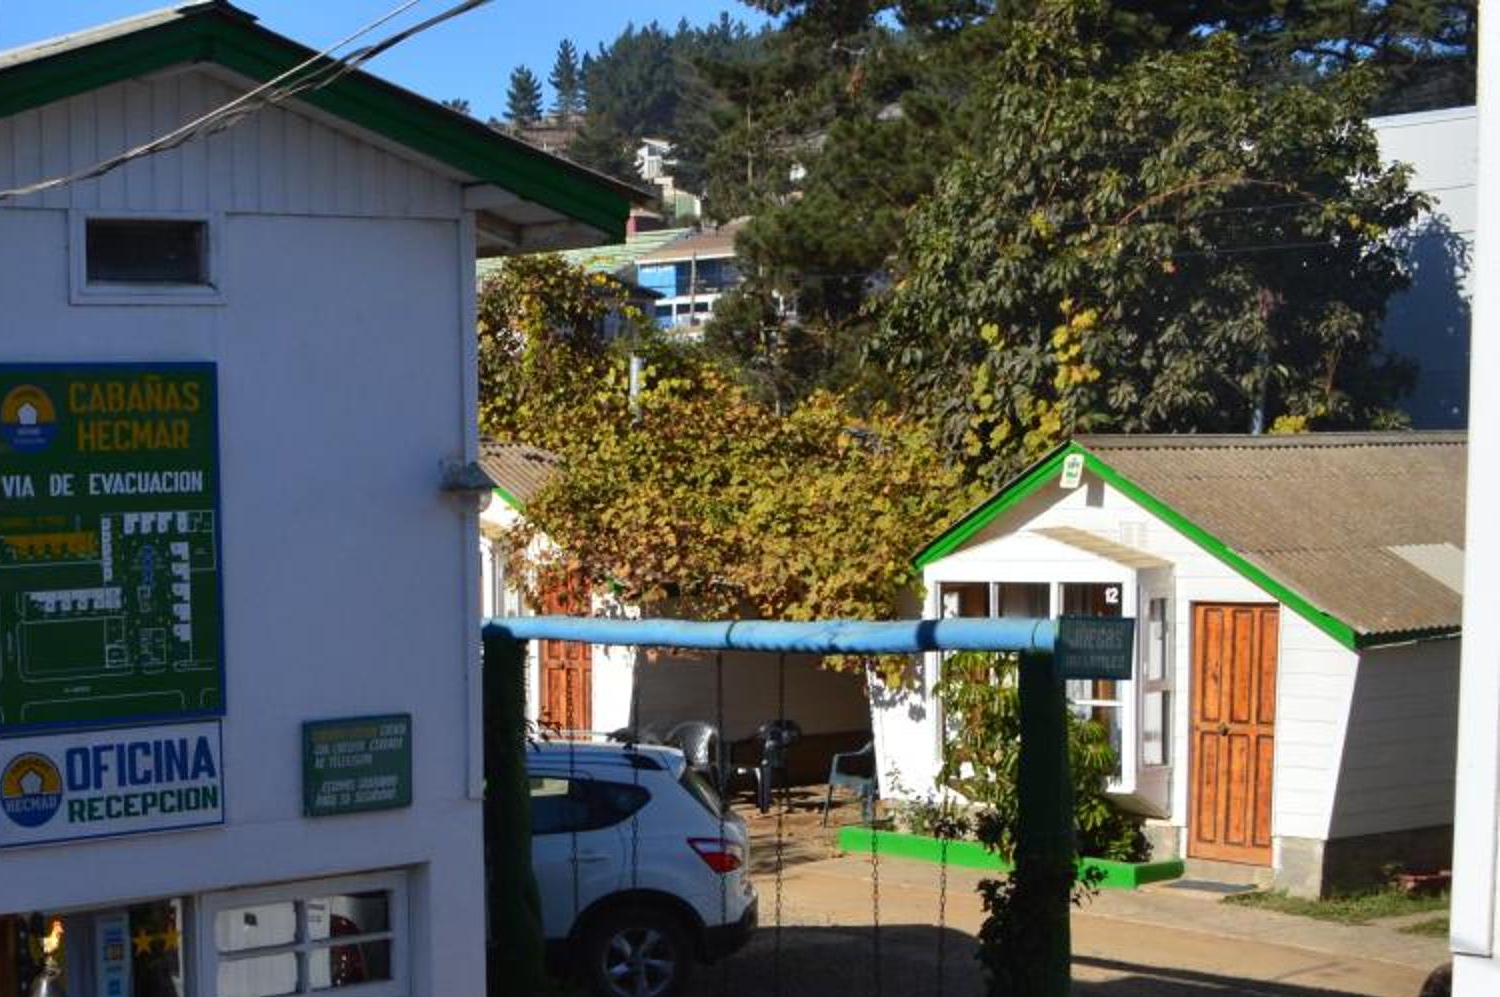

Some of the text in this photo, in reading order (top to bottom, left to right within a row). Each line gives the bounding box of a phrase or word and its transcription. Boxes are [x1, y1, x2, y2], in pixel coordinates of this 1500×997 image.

[68, 374, 200, 413] CABAÑAS
[78, 417, 190, 451] HECMAR
[1, 469, 203, 498] VIA DE EVACUACION
[1104, 586, 1120, 604] 12
[65, 736, 217, 792] OFICINA
[67, 785, 219, 824] RECEPCION
